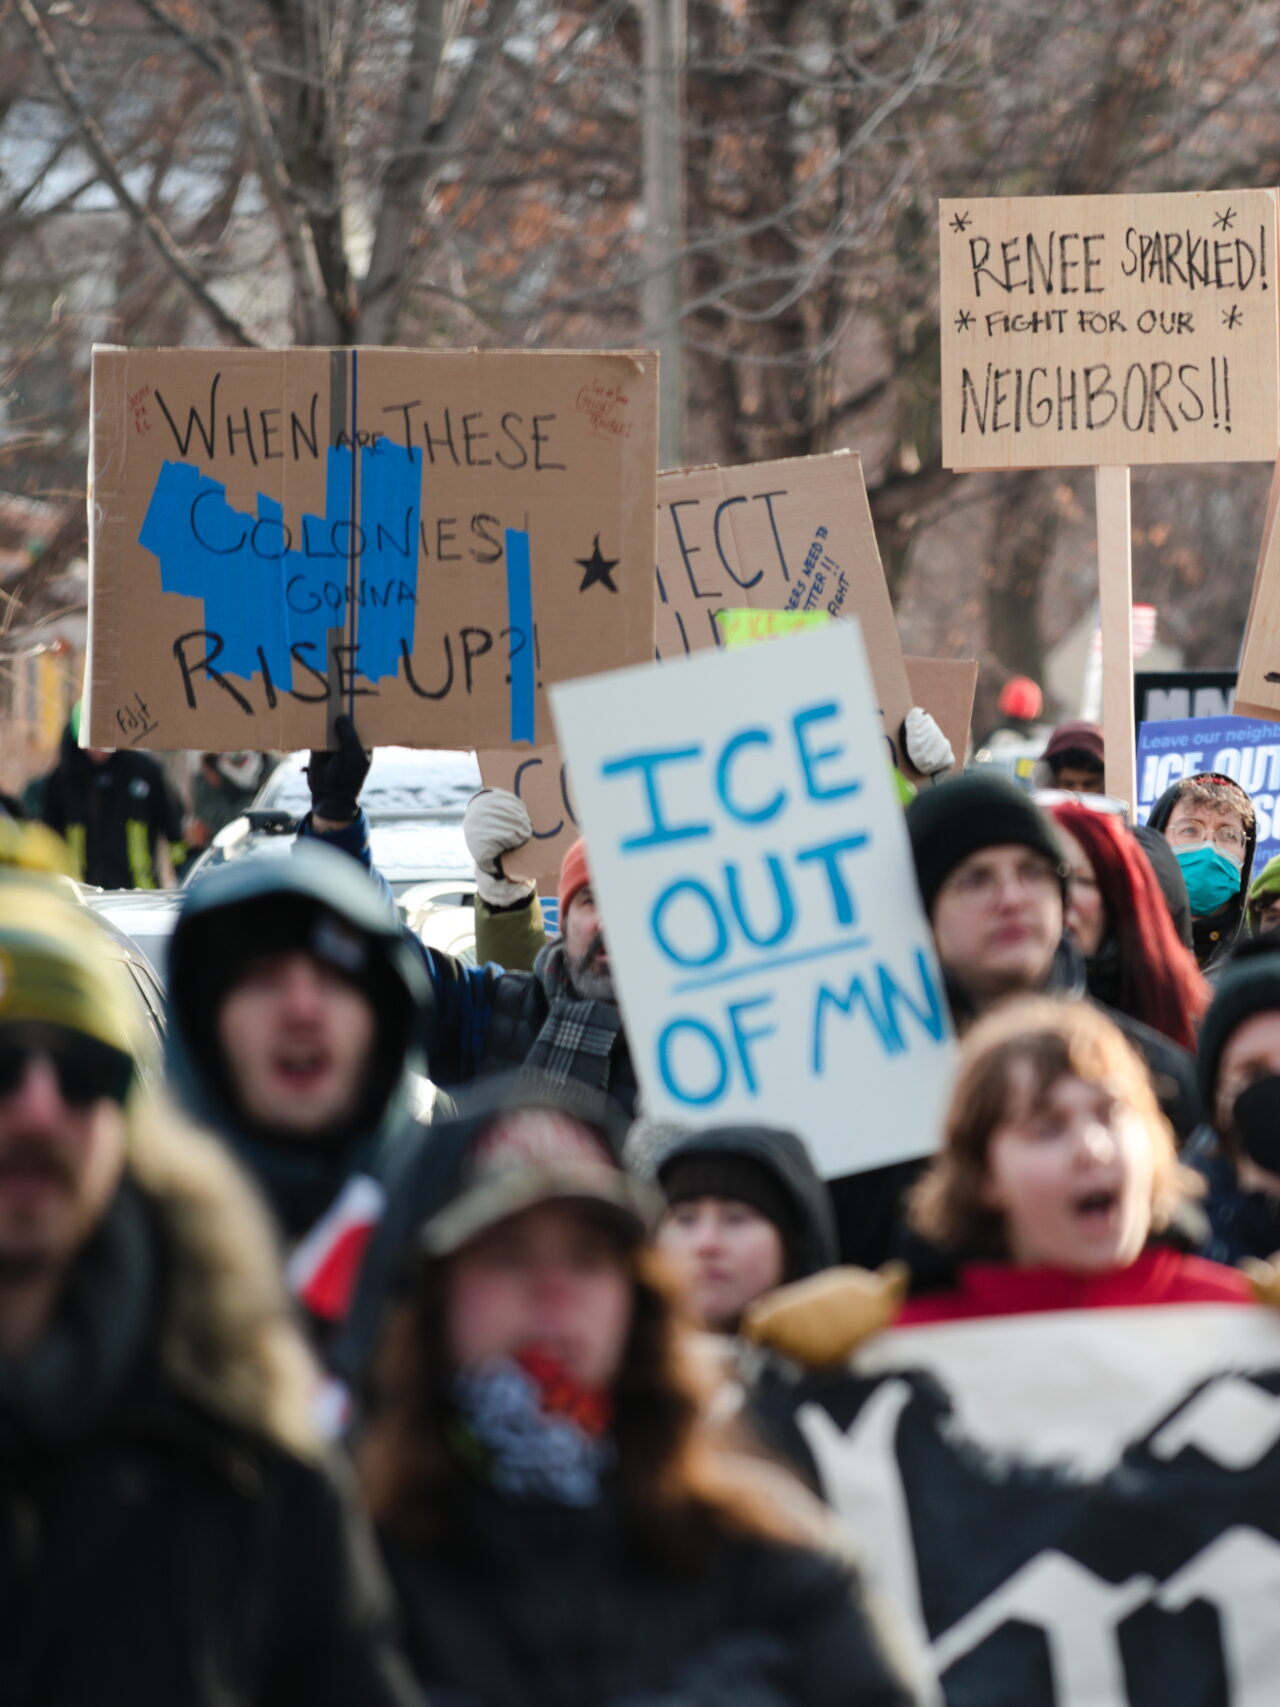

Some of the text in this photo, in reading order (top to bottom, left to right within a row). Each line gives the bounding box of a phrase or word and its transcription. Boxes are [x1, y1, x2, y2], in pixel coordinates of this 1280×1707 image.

[969, 224, 1269, 297] RENEE SPARKLED!
[985, 309, 1195, 336] FIGHT FOR OUR
[154, 372, 319, 467] WHEN
[382, 400, 567, 471] THESE
[960, 356, 1232, 435] NEIGHBORS!!
[190, 487, 503, 565] COLONIES
[657, 490, 790, 604] ECT
[802, 541, 824, 577] NEED
[286, 573, 418, 614] GONNA
[173, 630, 379, 716] RISE
[601, 700, 864, 854] ICE
[1141, 751, 1204, 802] ICE
[1142, 735, 1190, 750] Leave
[1193, 732, 1222, 746] our
[649, 830, 870, 969] OUT
[655, 944, 949, 1107] OF MN
